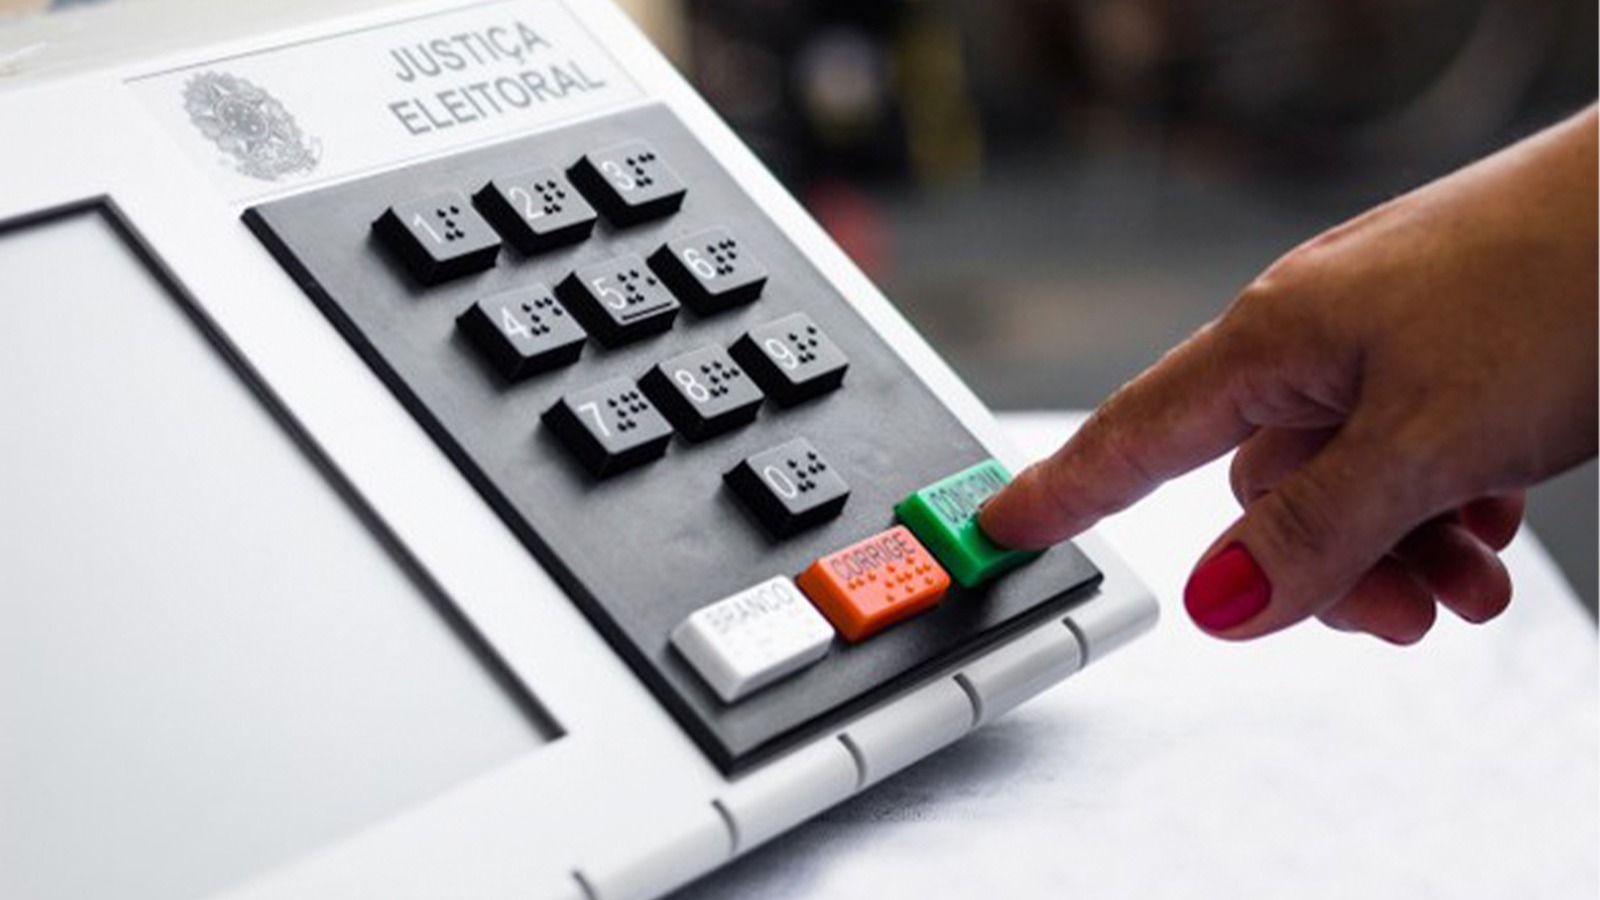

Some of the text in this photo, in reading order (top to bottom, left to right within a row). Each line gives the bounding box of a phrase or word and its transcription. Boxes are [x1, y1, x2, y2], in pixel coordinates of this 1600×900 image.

[391, 22, 552, 82] JUSTIÇA
[388, 60, 606, 135] ELEITORAL
[602, 161, 635, 191] 3
[509, 187, 543, 219] 2
[413, 213, 441, 244] 1
[684, 248, 716, 280] 6
[593, 277, 626, 310] 5
[500, 307, 532, 340] 4
[764, 338, 798, 370] 9
[676, 370, 709, 402] 8
[578, 402, 610, 436] 7
[764, 466, 796, 500] 0
[831, 532, 915, 579] CORRIGE
[704, 582, 793, 634] BRANCO
